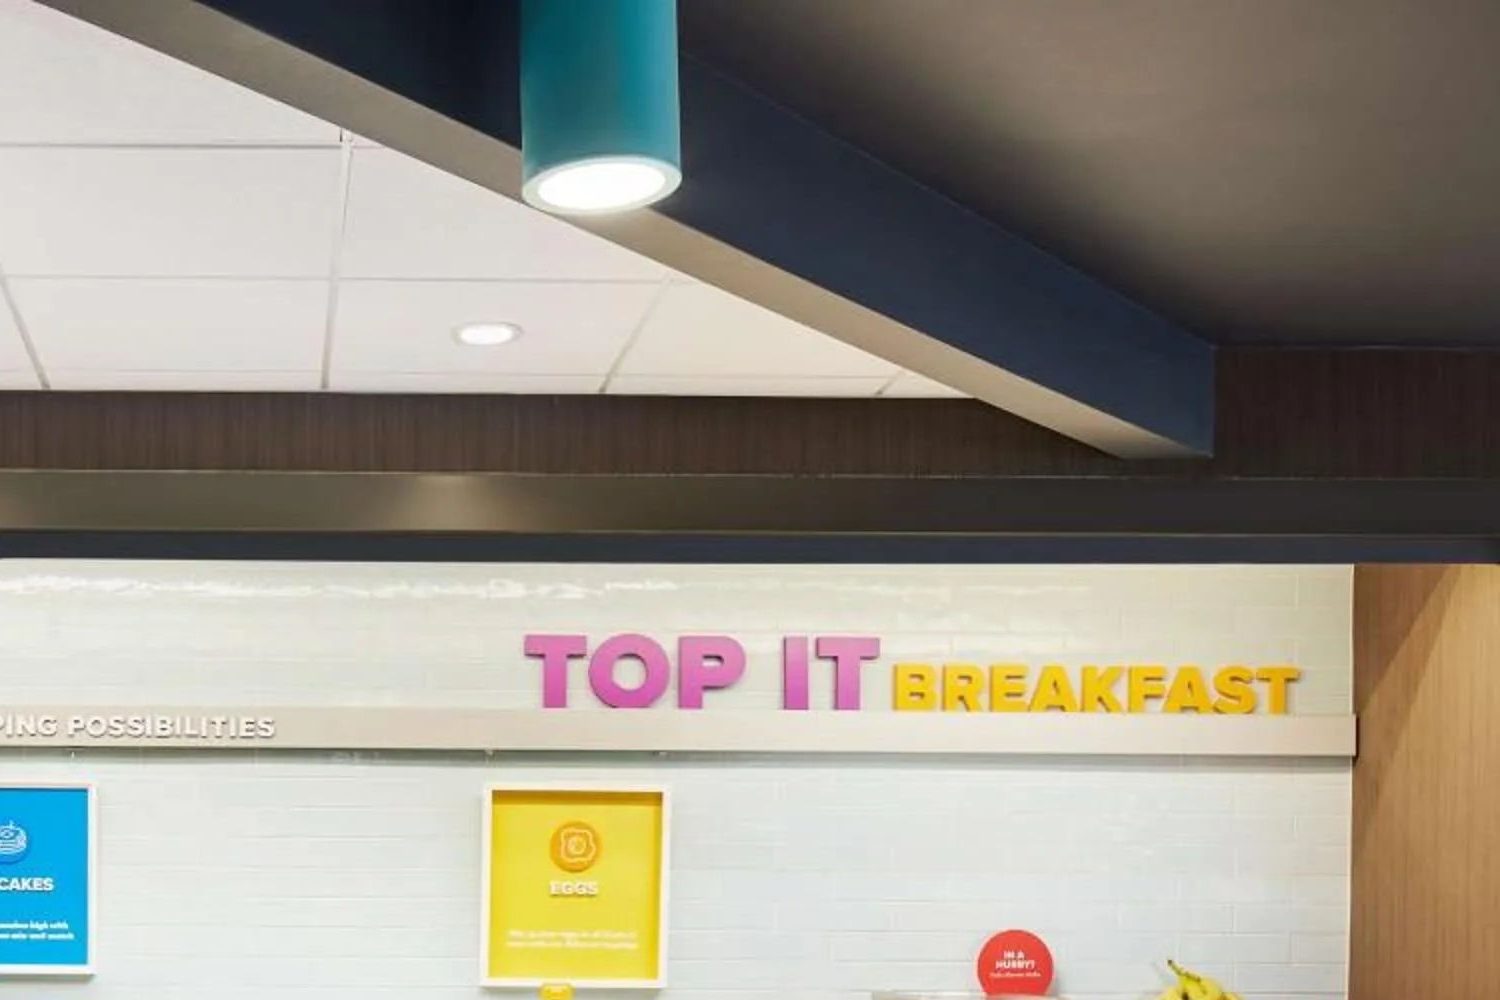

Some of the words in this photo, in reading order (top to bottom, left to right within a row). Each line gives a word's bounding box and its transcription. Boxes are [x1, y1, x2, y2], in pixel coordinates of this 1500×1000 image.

[524, 633, 747, 709] TOP
[782, 635, 881, 710] IT
[892, 663, 1300, 714] BREAKFAST
[66, 714, 277, 738] POSSIBILITIES
[549, 881, 598, 896] EGGS
